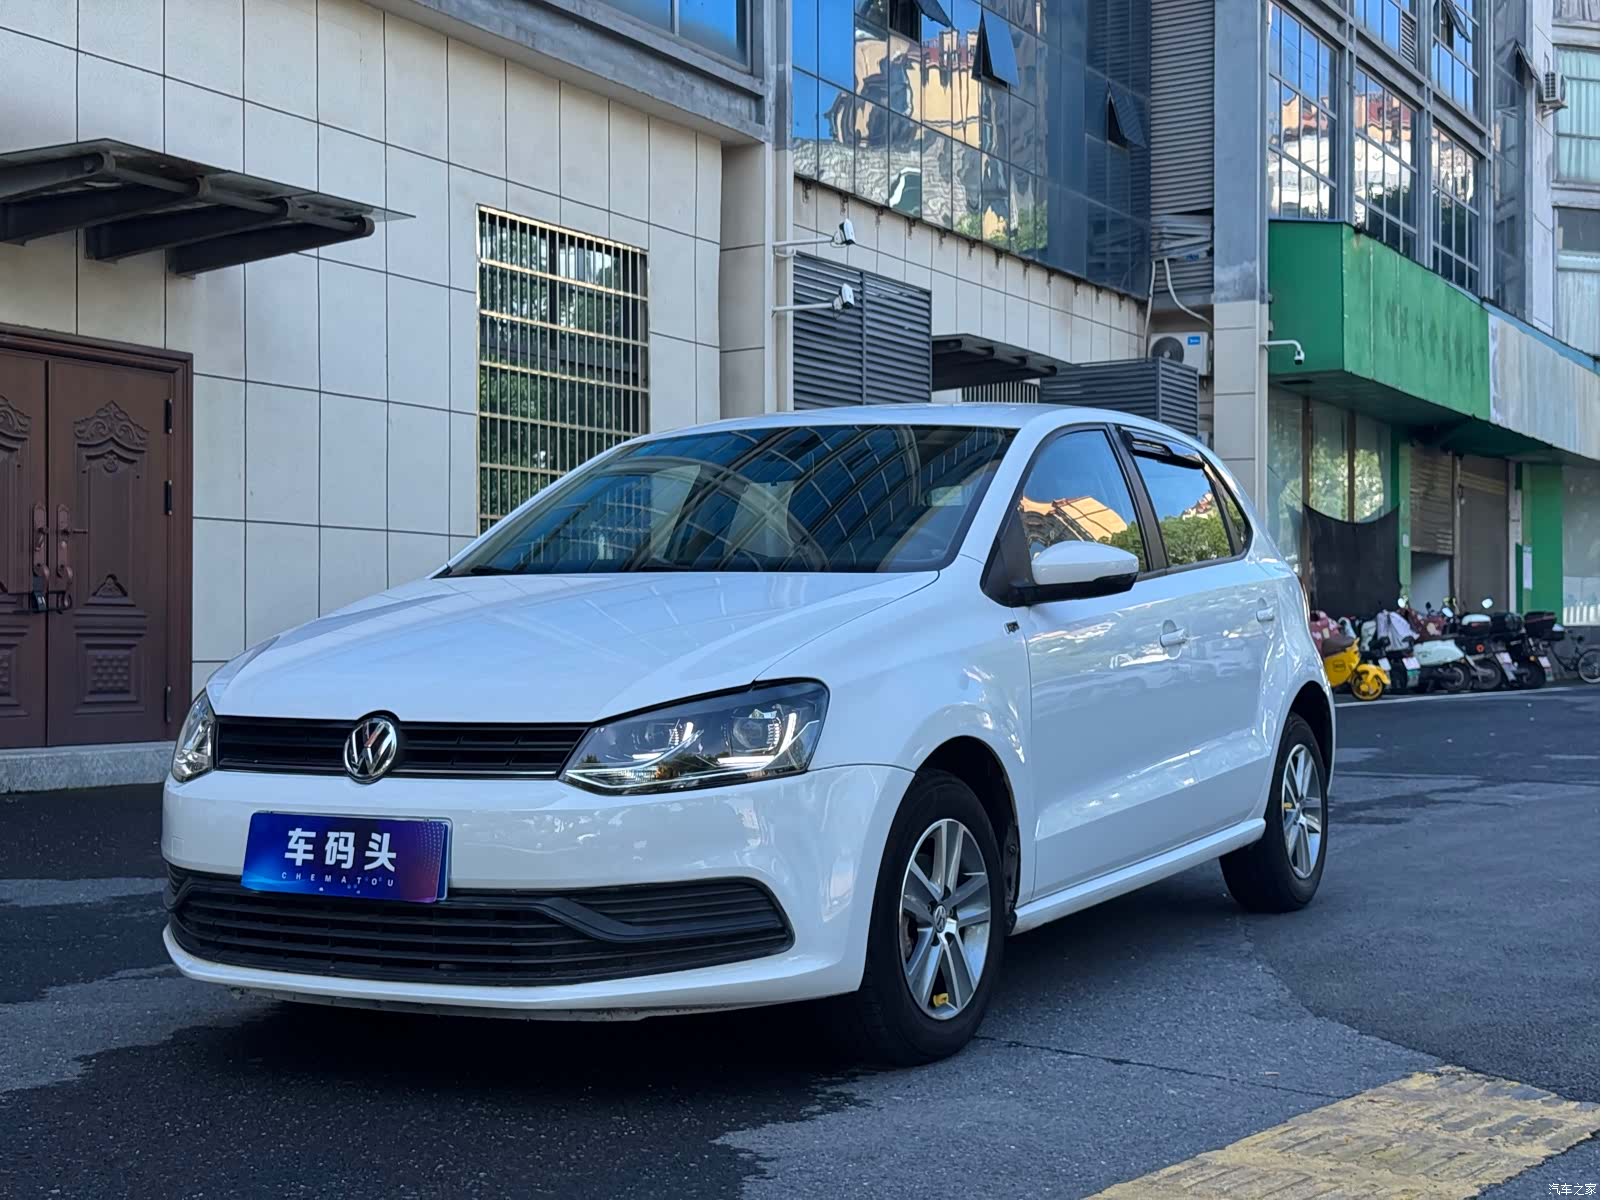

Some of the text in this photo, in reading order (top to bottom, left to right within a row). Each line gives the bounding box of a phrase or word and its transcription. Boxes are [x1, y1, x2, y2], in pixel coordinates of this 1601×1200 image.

[284, 828, 397, 872] 车码头
[281, 871, 394, 887] CHEMATOU
